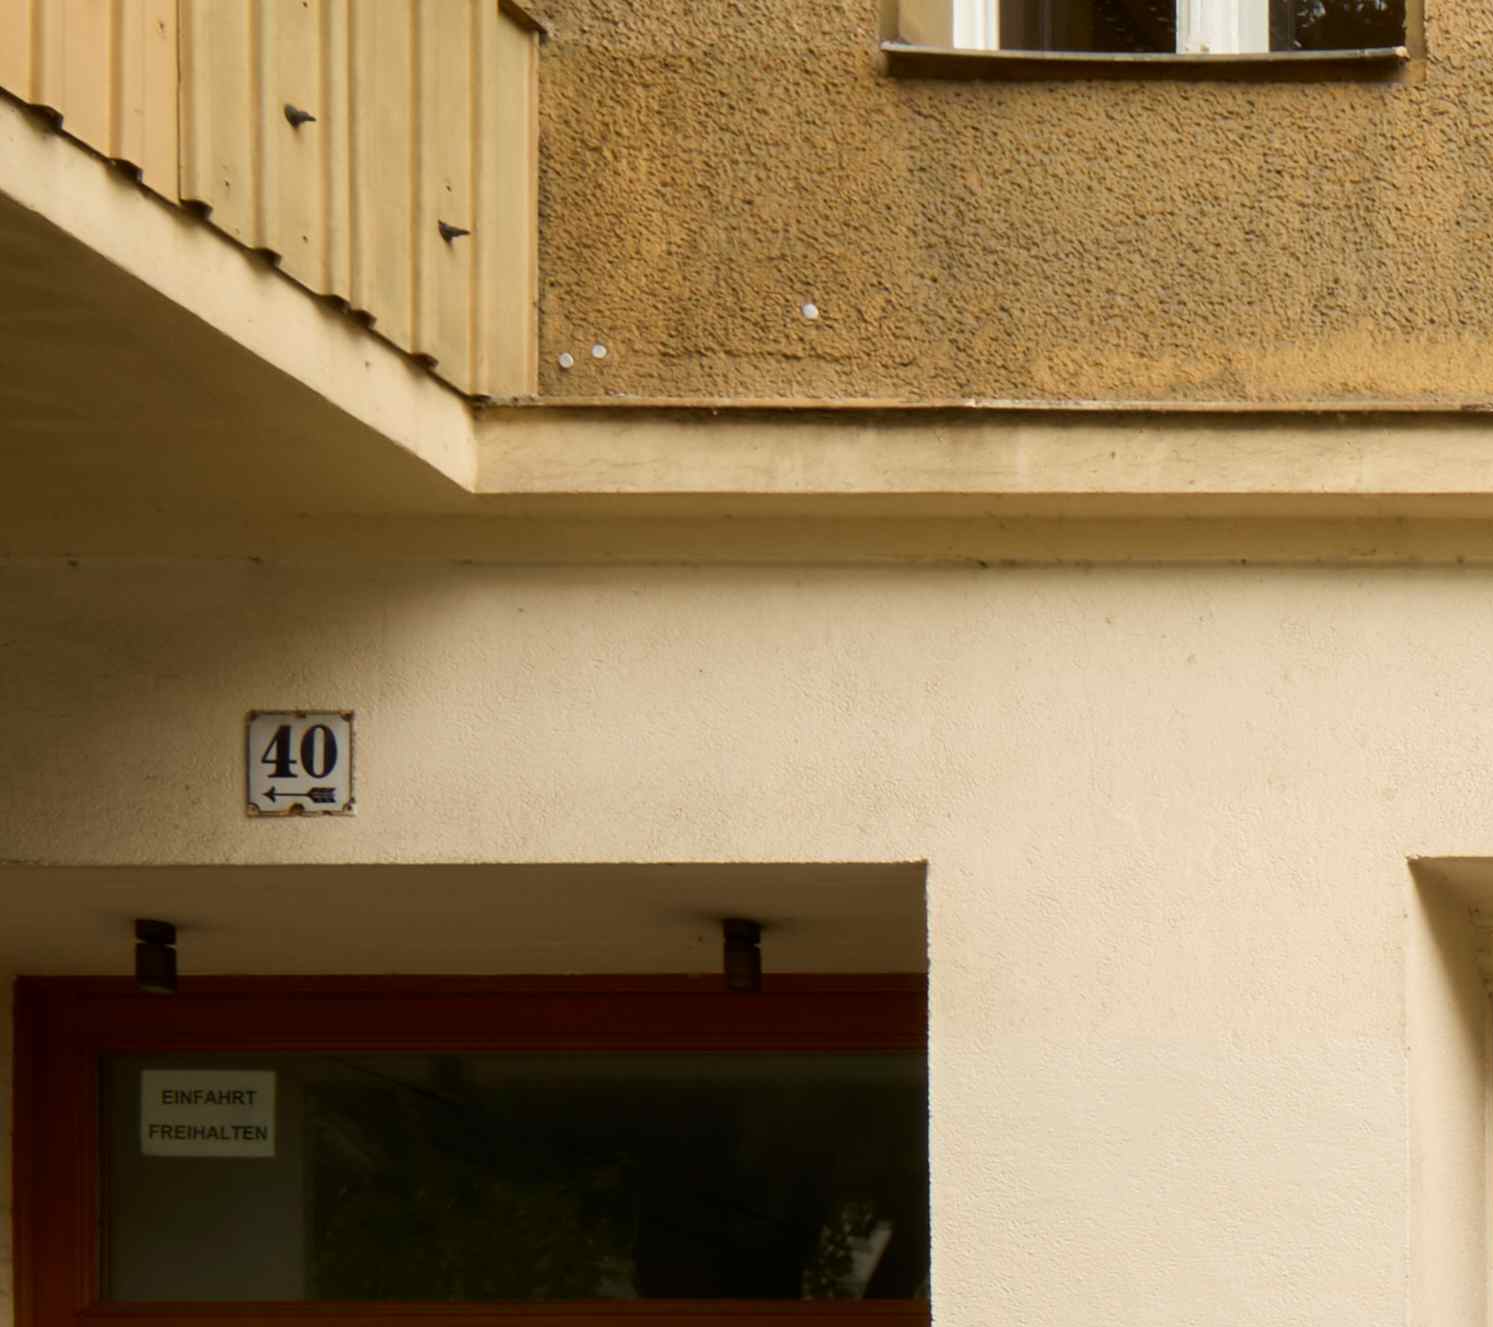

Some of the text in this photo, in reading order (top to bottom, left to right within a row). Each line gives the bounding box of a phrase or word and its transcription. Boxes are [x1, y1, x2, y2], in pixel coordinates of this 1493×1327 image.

[260, 723, 339, 779] 40
[161, 1088, 258, 1105] EINFAHRT
[148, 1123, 269, 1141] FREIHALTEN
